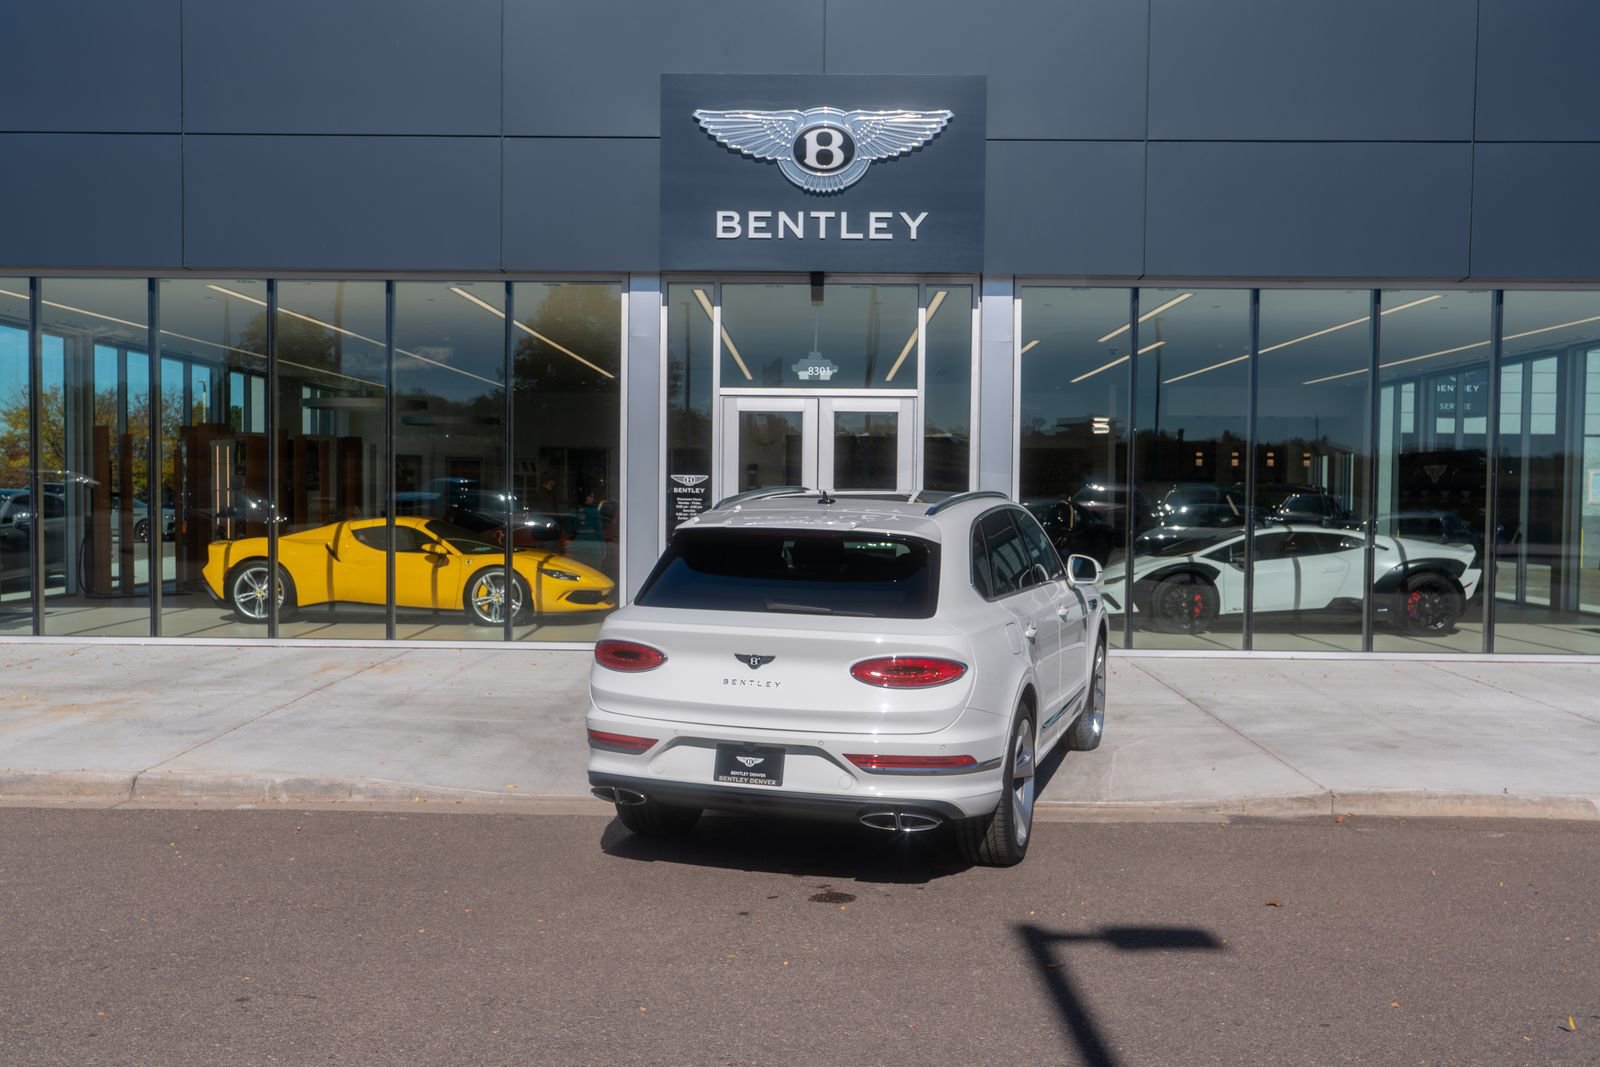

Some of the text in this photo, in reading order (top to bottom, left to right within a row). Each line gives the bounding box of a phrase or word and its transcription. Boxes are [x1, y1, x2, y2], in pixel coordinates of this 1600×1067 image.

[716, 211, 929, 240] BENTLEY
[808, 366, 830, 376] 8301
[722, 678, 781, 688] BENTLEY
